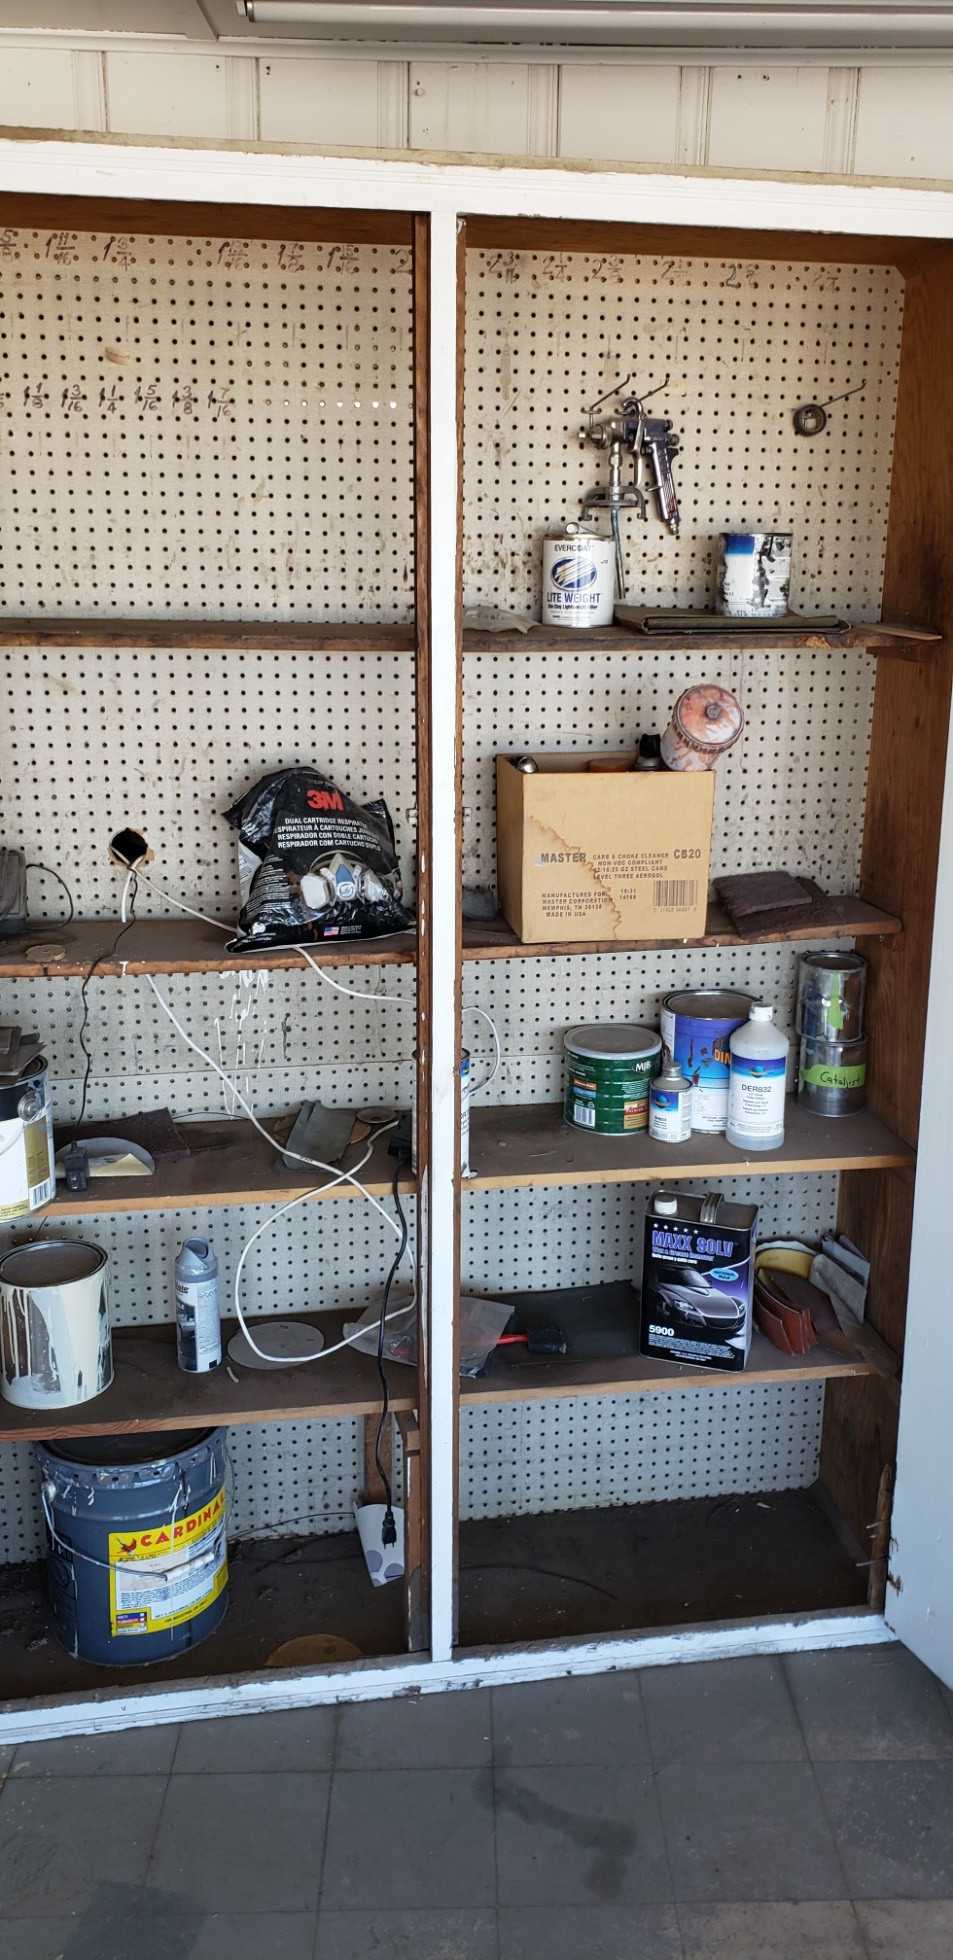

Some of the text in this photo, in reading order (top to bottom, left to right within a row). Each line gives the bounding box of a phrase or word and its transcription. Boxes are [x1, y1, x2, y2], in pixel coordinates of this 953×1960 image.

[564, 592, 601, 604] WEIGHT
[307, 790, 344, 811] 3M
[285, 817, 301, 825] DUAL
[320, 824, 357, 832] CARTOUCHES
[277, 832, 318, 841] RESPIRADOR
[278, 840, 318, 849] RESPIRADOR
[541, 852, 586, 863] MASTER
[820, 1071, 861, 1088] Catalyst
[652, 1230, 692, 1252] MAXX
[648, 1324, 675, 1337] 5900
